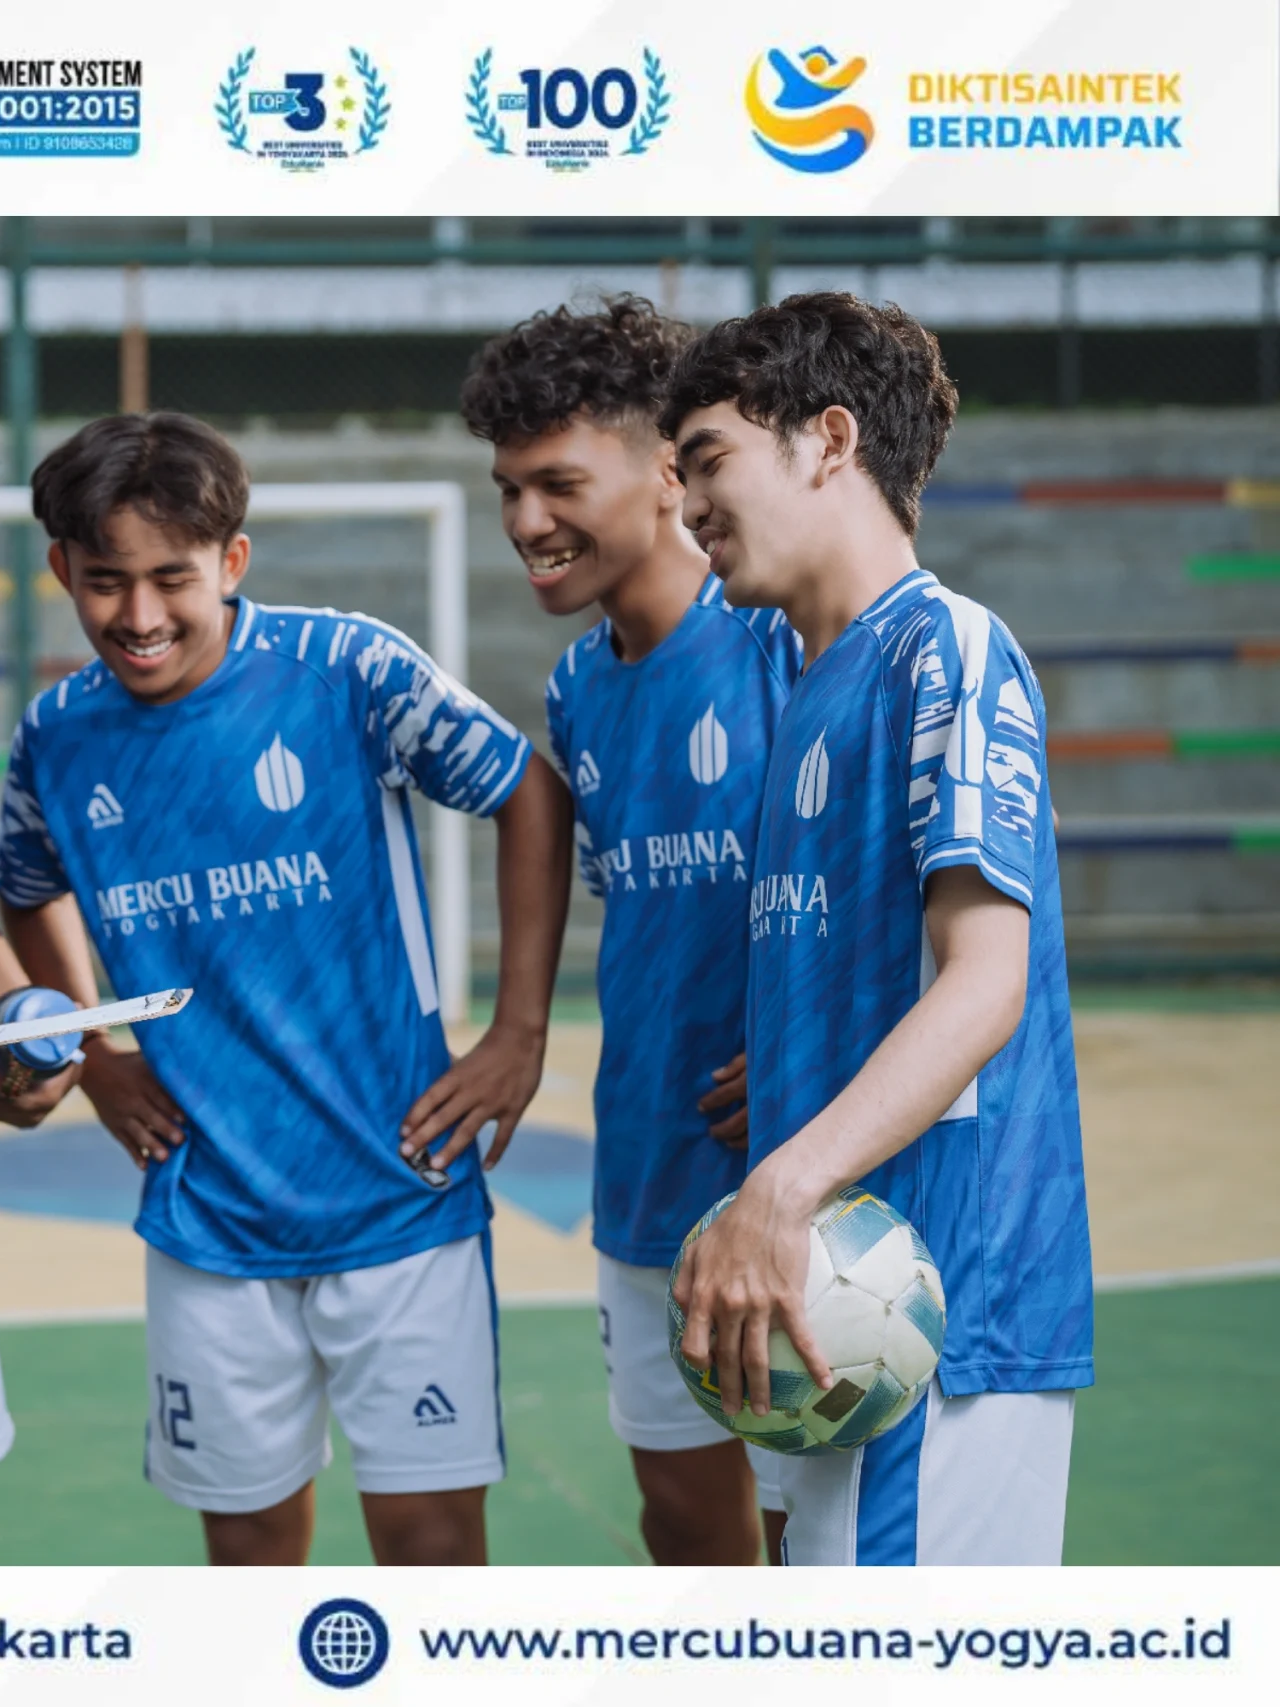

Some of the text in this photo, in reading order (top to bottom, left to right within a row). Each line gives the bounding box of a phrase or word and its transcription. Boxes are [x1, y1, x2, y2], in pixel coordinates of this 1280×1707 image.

[646, 829, 745, 869] BUANA
[96, 851, 329, 920] MERCU BUANA
[102, 884, 332, 939] YOGYAKARTA
[156, 1374, 196, 1450] 12
